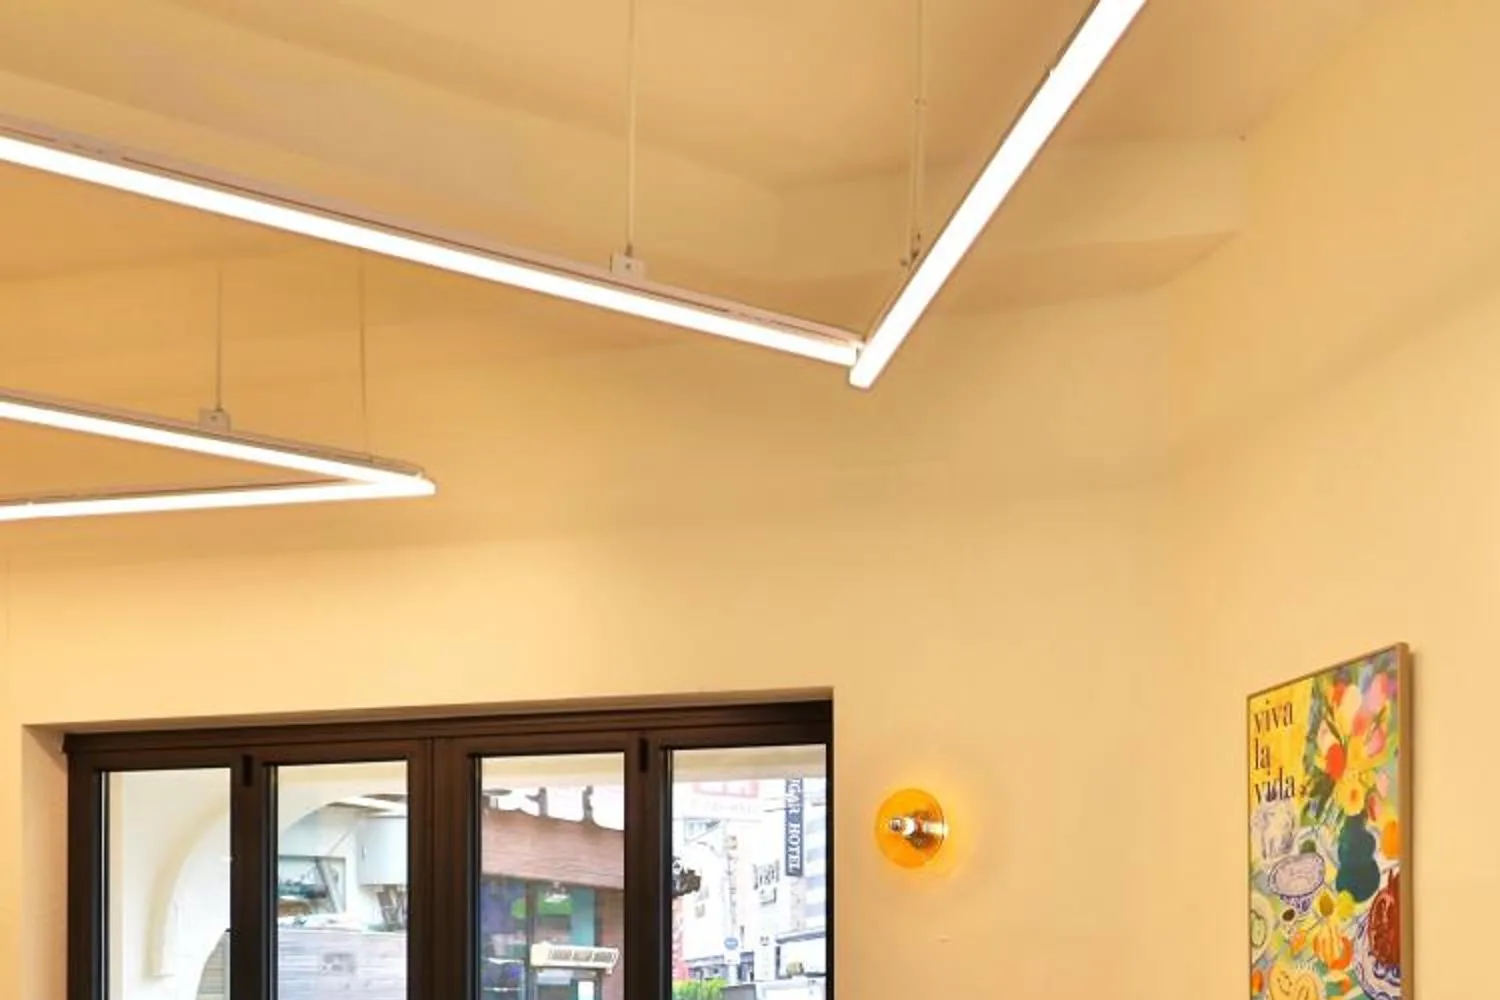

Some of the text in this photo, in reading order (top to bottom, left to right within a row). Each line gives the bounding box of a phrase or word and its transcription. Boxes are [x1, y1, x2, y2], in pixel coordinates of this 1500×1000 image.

[1254, 699, 1293, 733] viva
[1254, 737, 1271, 770] la
[1254, 767, 1295, 802] vida
[786, 822, 802, 873] HOTEL
